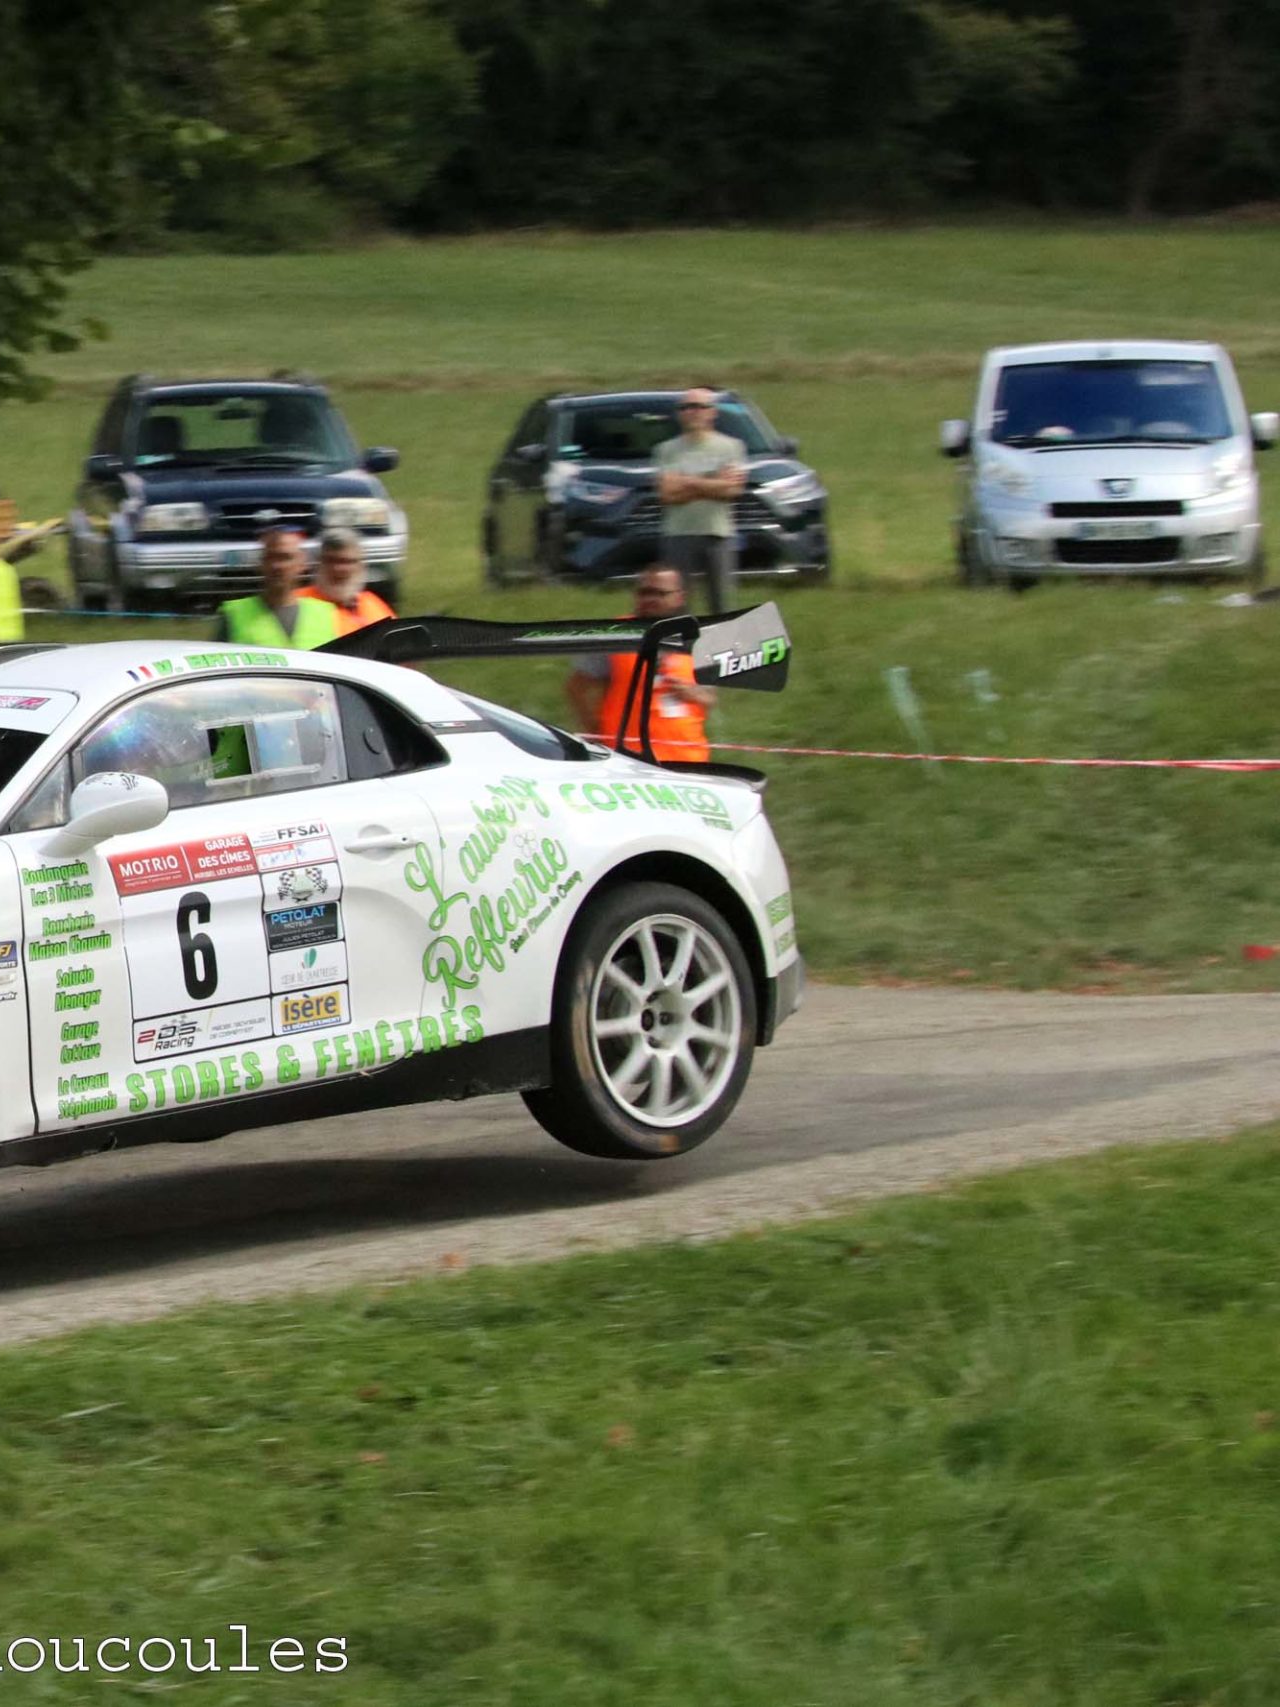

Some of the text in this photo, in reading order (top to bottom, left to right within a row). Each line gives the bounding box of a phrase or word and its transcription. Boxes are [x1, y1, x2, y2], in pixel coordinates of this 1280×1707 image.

[204, 835, 246, 850] GARAGE
[277, 824, 320, 840] FFSA
[197, 854, 219, 869] DES
[219, 849, 251, 866] CÎMES
[21, 859, 89, 885] Boulangerie
[30, 888, 49, 907] Les
[55, 881, 95, 903] Miches
[42, 911, 96, 937] Boucherie
[270, 905, 326, 925] PETOLAT
[28, 930, 112, 961] Maison Chauvin
[175, 891, 219, 1001] 6
[283, 992, 337, 1022] isère
[60, 1020, 100, 1042] Garage
[154, 1035, 195, 1051] Racing
[125, 1004, 486, 1113] STORES & FENÊTRES
[57, 1072, 110, 1097] Le Caveau
